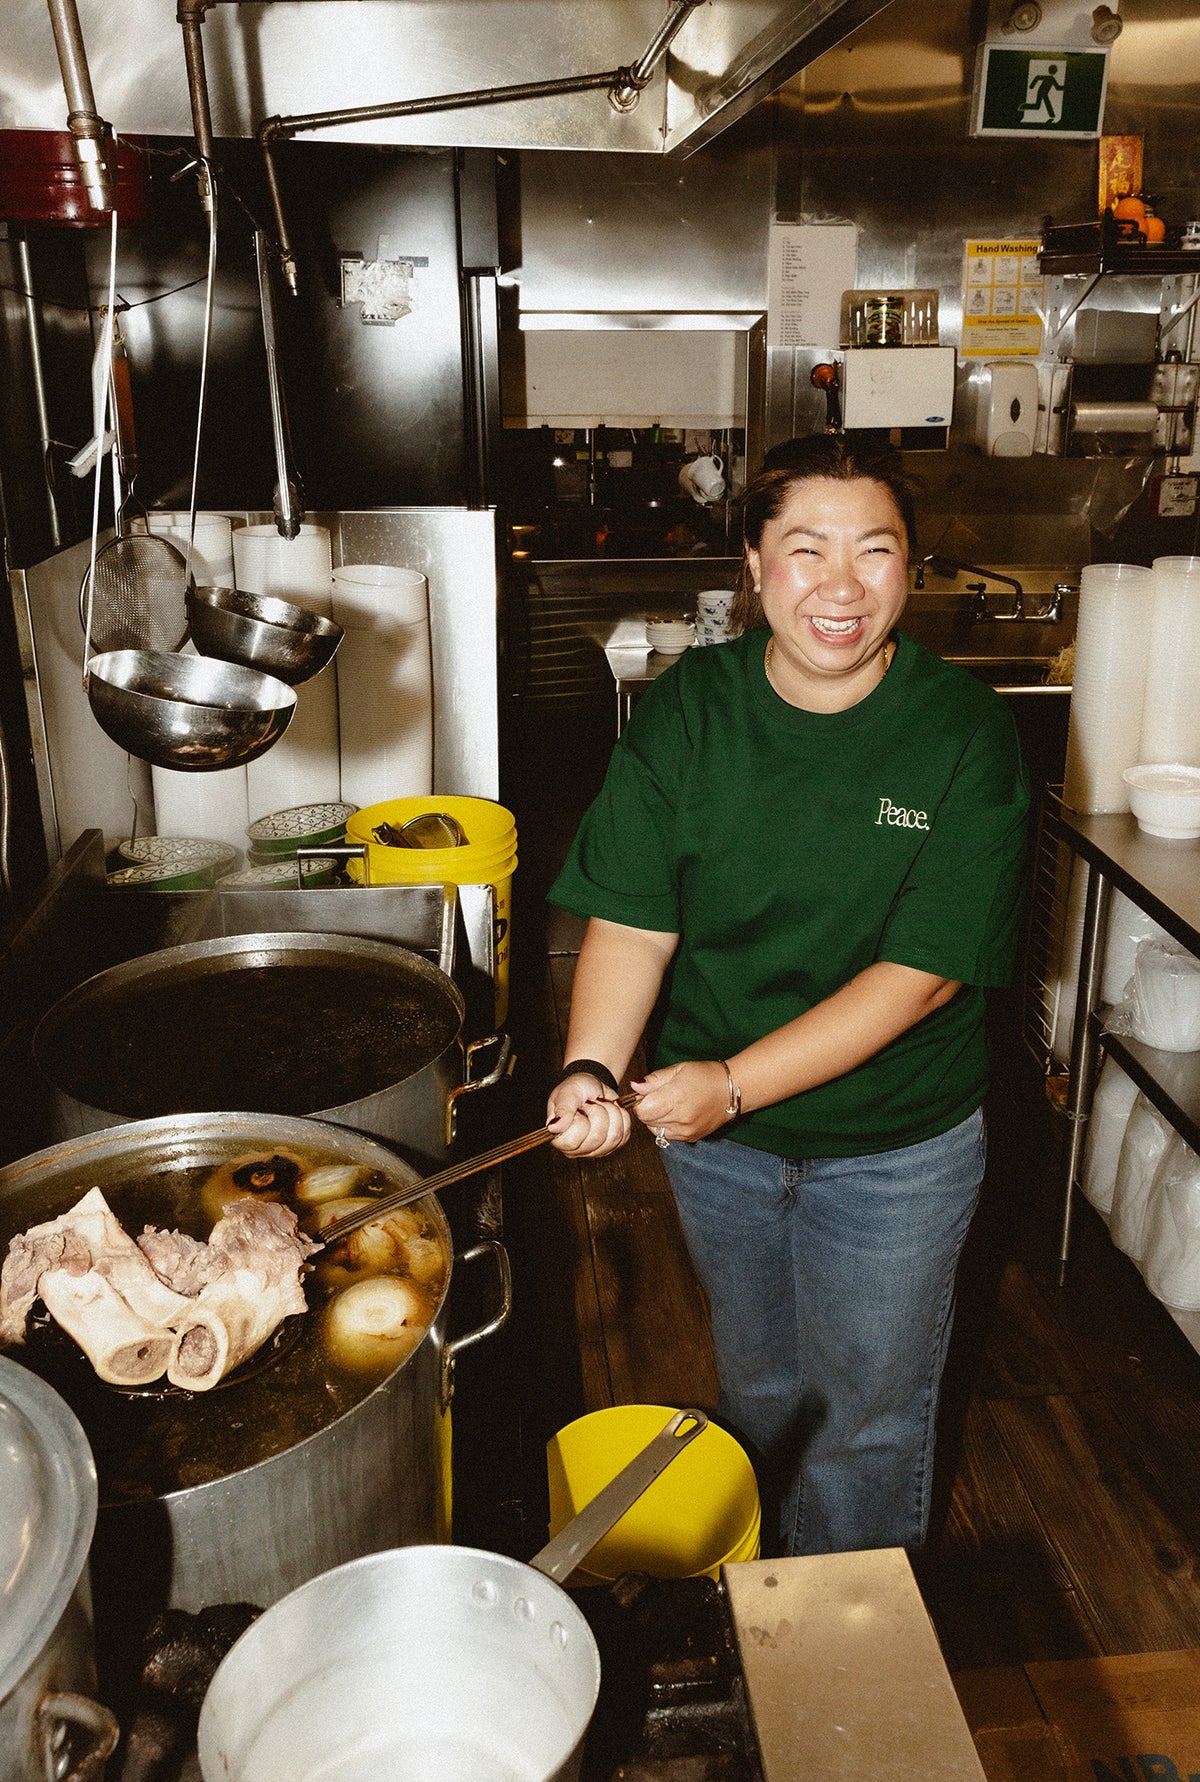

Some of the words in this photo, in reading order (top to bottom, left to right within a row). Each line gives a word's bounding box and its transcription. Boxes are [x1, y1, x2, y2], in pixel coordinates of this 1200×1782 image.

[976, 244, 999, 253] Hand
[1000, 244, 1038, 254] Washing
[874, 797, 930, 831] Peace.
